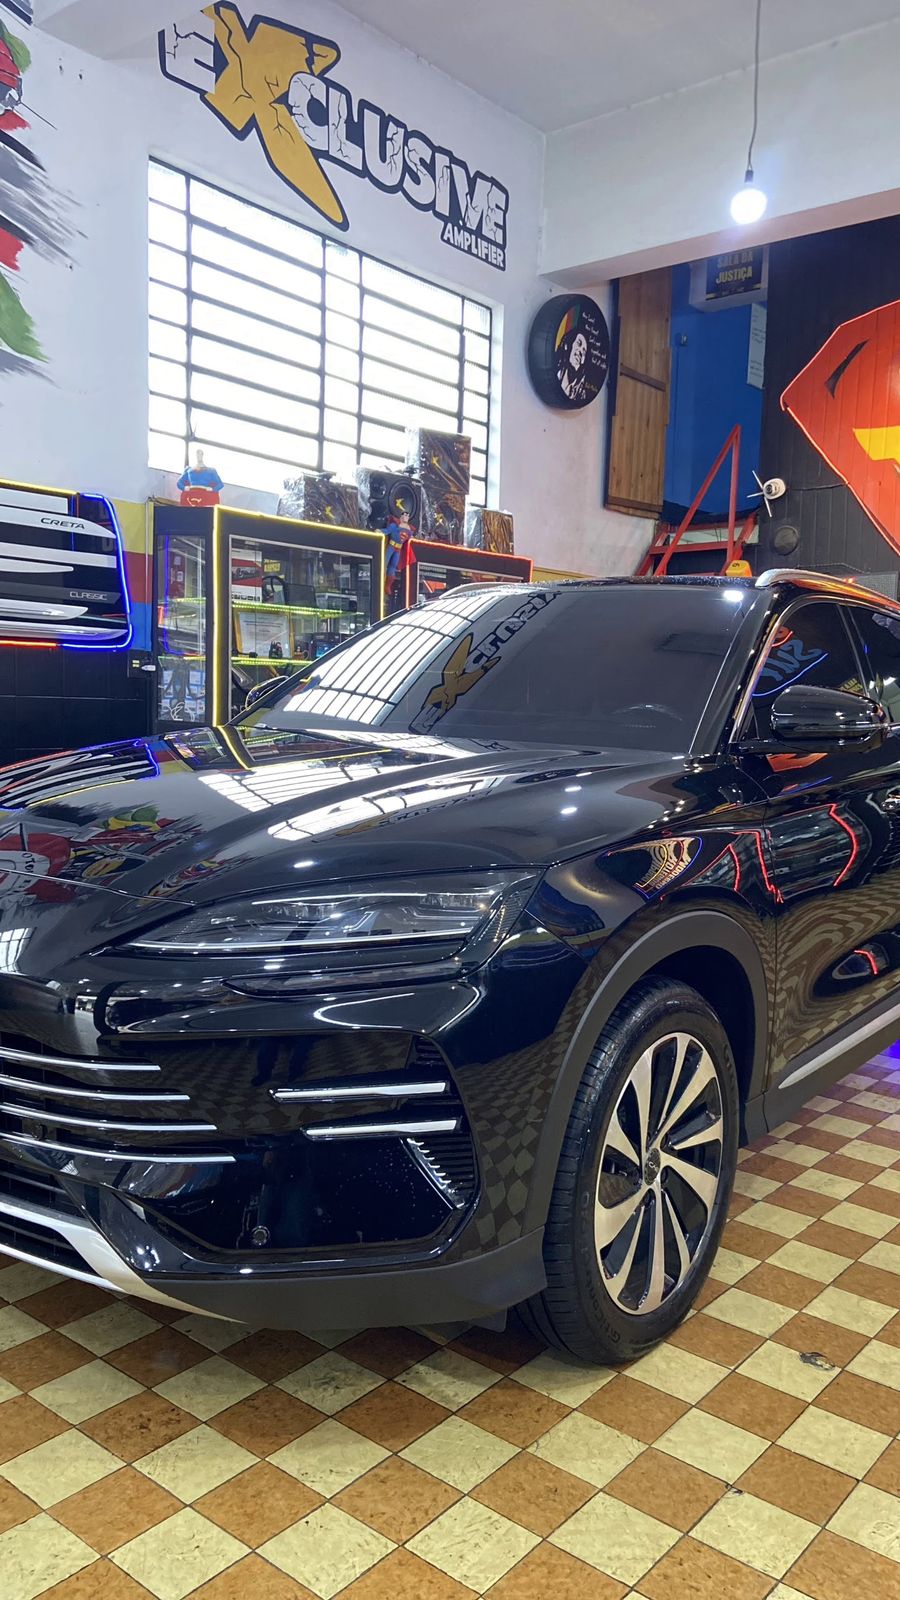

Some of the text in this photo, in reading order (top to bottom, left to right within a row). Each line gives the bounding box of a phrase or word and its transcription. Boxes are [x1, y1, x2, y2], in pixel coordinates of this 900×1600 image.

[442, 222, 505, 269] AMPLIFIER
[715, 266, 753, 284] JUSTIÇA
[40, 517, 85, 530] CRETA
[69, 591, 108, 601] CLASSIC
